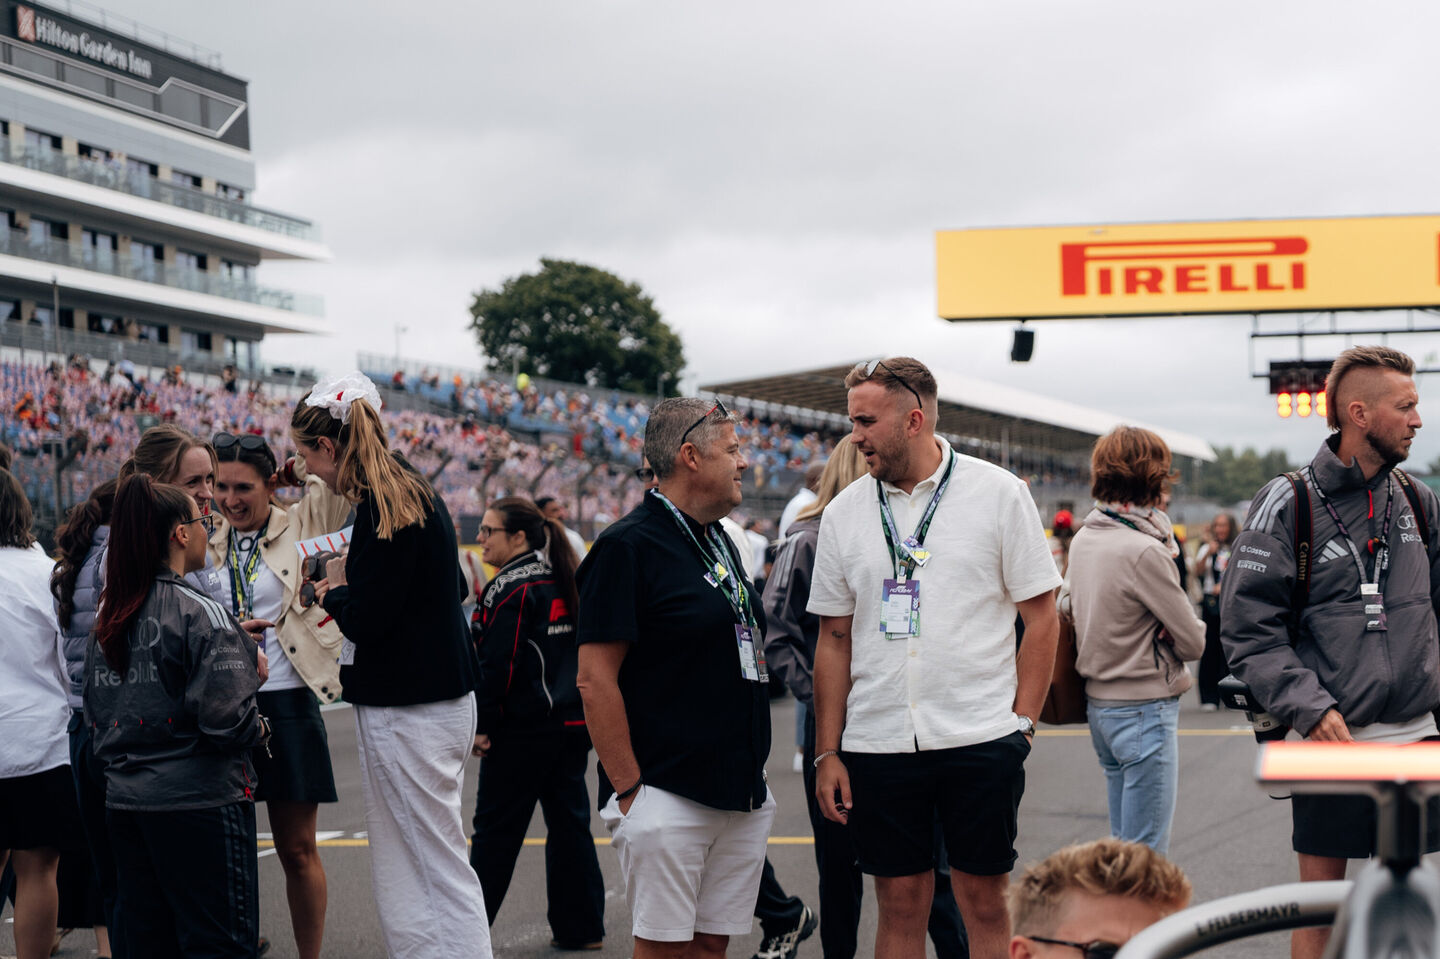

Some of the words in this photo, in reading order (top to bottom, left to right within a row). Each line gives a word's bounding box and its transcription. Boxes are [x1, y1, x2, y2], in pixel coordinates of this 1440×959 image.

[35, 15, 80, 54] Hilton
[80, 32, 128, 71] Garden
[128, 49, 152, 79] Inn
[1061, 237, 1309, 296] PIRELLI
[1247, 546, 1271, 558] Castrol
[95, 661, 158, 687] Reolut
